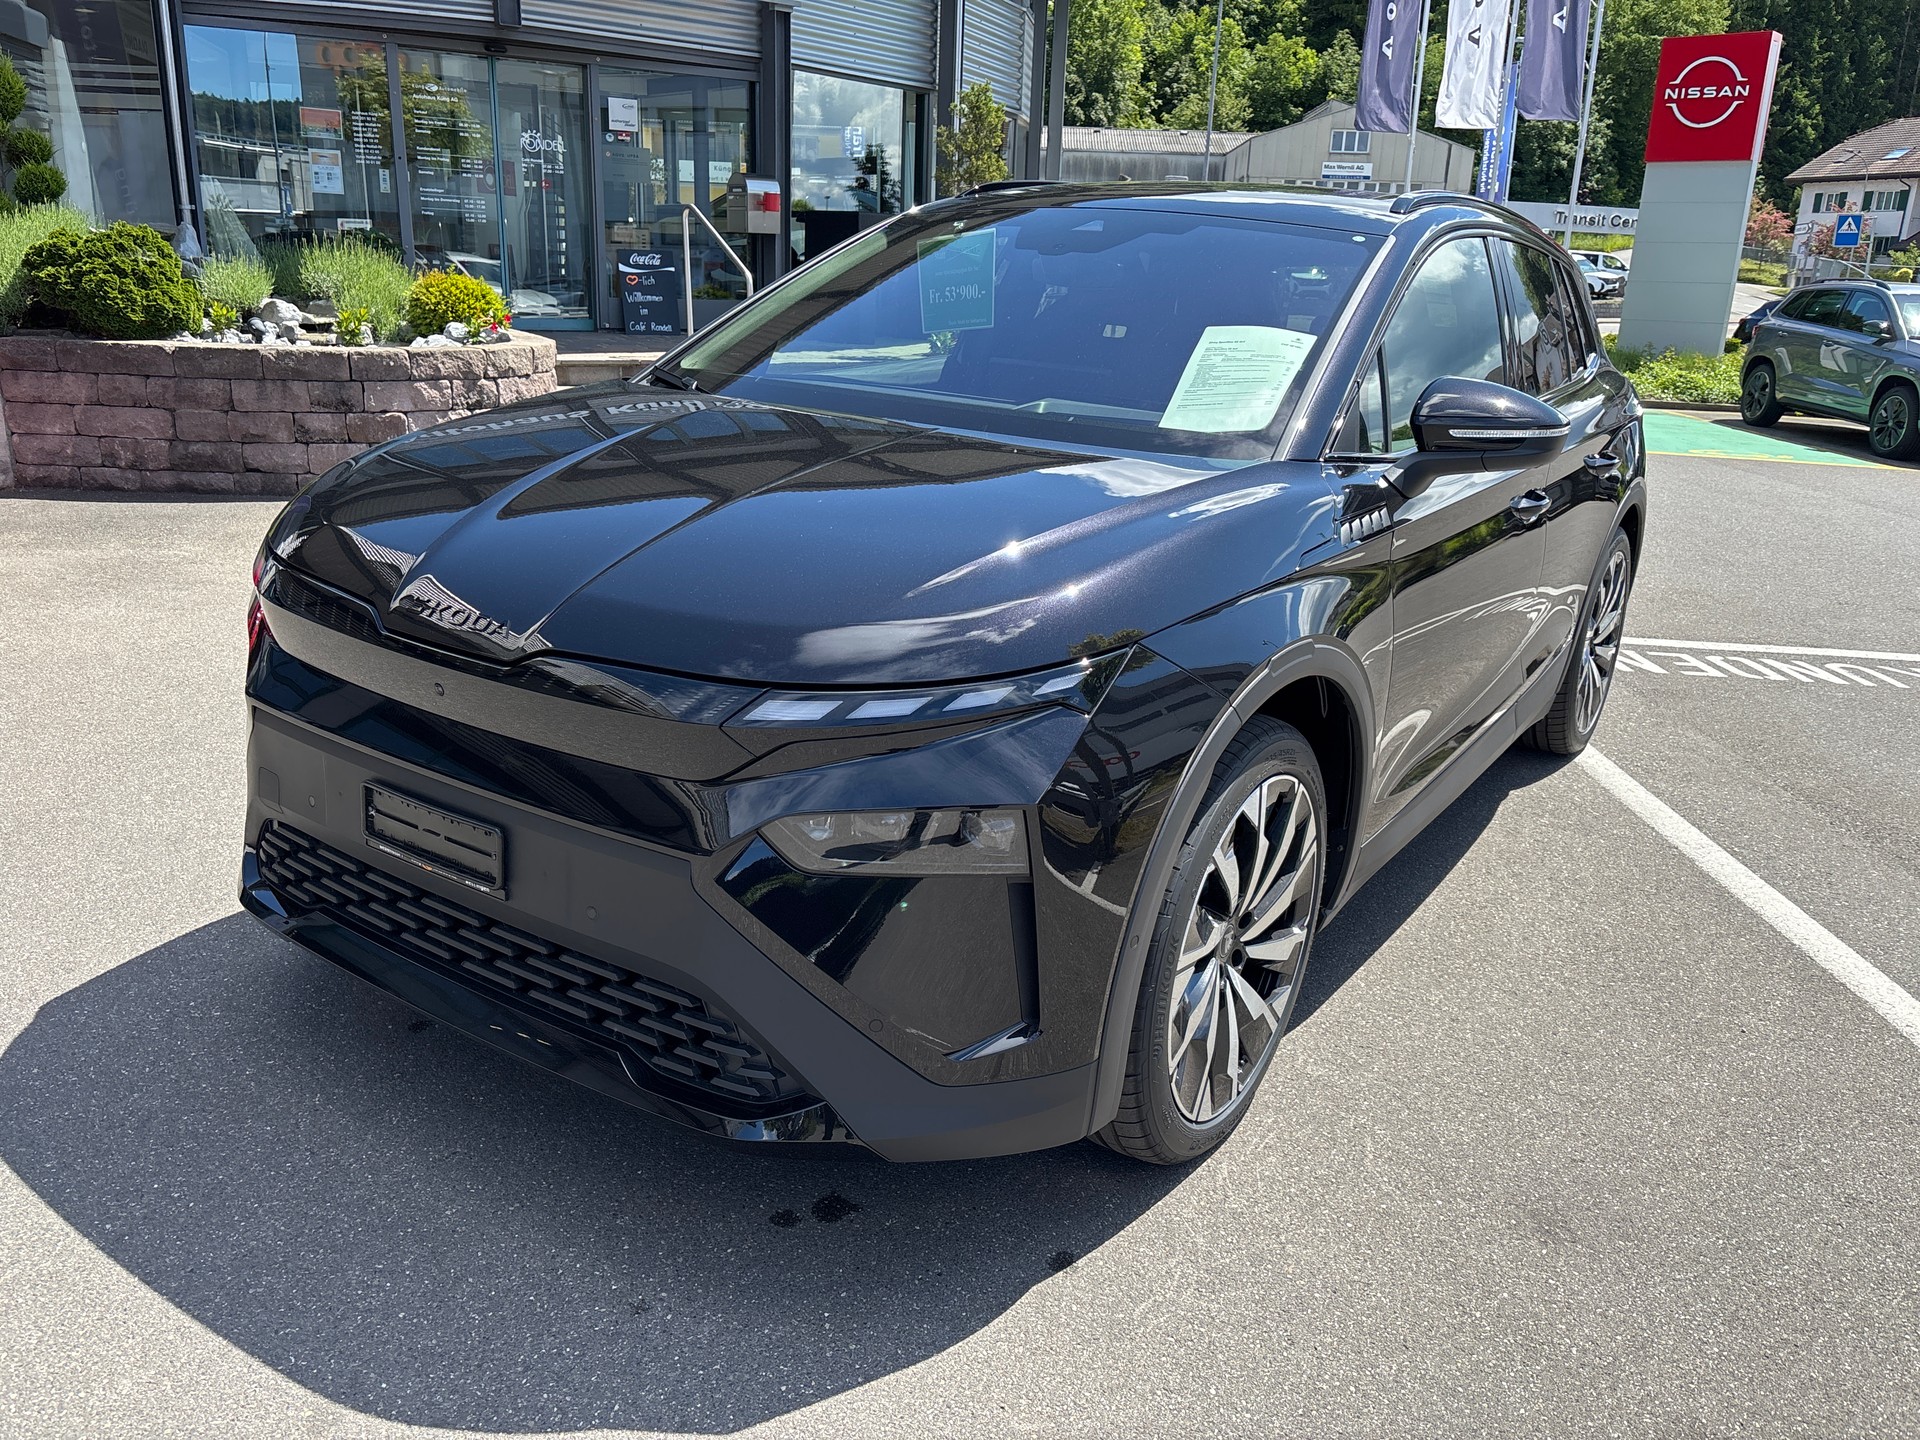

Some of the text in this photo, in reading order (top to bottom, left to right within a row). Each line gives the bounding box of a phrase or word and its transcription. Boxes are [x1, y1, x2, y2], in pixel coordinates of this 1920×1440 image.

[412, 93, 436, 101] Autohaus
[437, 95, 450, 103] Küng
[1664, 84, 1750, 101] NISSAN
[624, 291, 664, 304] Willkommen
[928, 288, 943, 304] Fr.
[639, 305, 649, 316] im
[629, 320, 673, 333] Café Rondell
